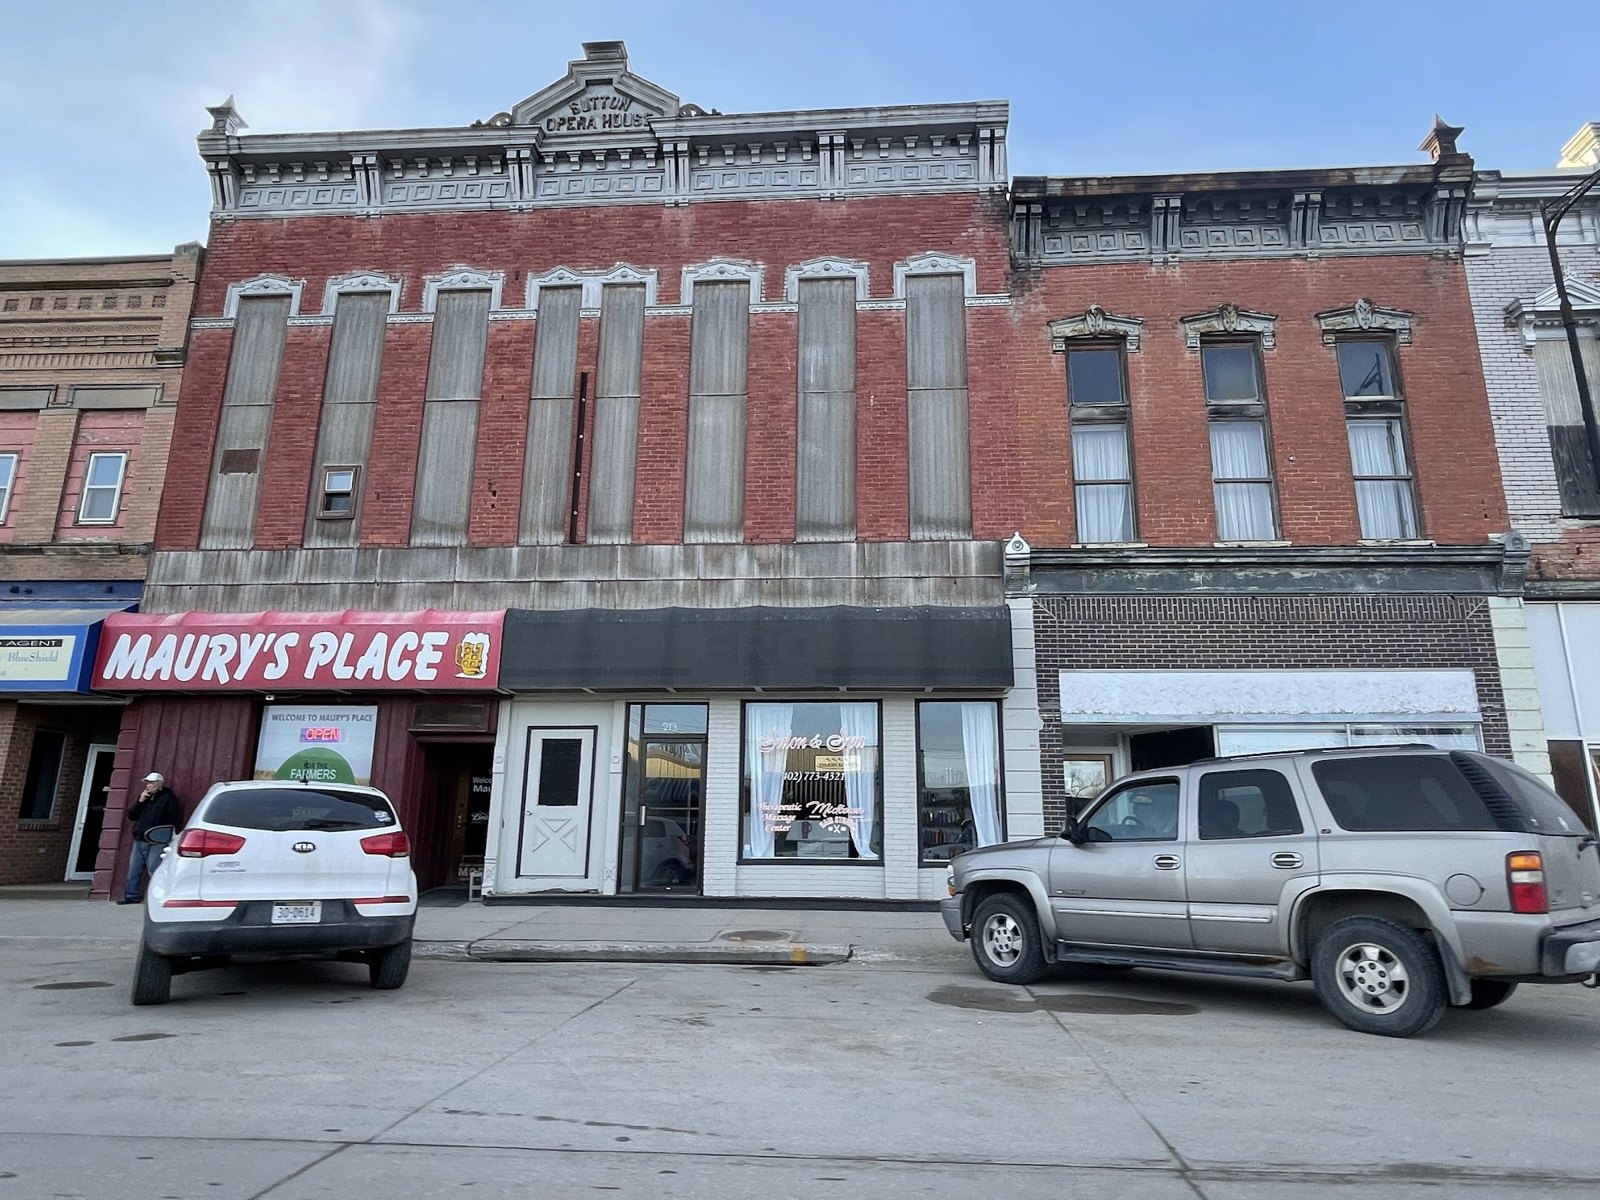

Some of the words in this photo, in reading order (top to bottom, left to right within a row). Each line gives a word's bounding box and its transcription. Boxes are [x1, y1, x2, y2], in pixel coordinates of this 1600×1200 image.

[568, 96, 632, 115] SUTTON
[546, 116, 597, 132] OPERA
[602, 113, 654, 129] HOUSE
[102, 633, 299, 685] MAURY'S
[303, 631, 449, 681] PLACE
[271, 714, 306, 722] WELCOME
[308, 714, 318, 722] TO
[319, 714, 350, 722] MAURY'S
[351, 714, 374, 722] PLACE
[662, 721, 678, 732] 213
[304, 728, 341, 741] OPEN
[809, 733, 822, 749] &
[290, 768, 337, 780] FARMERS
[804, 771, 846, 781] 773-4321
[294, 842, 314, 851] KIA
